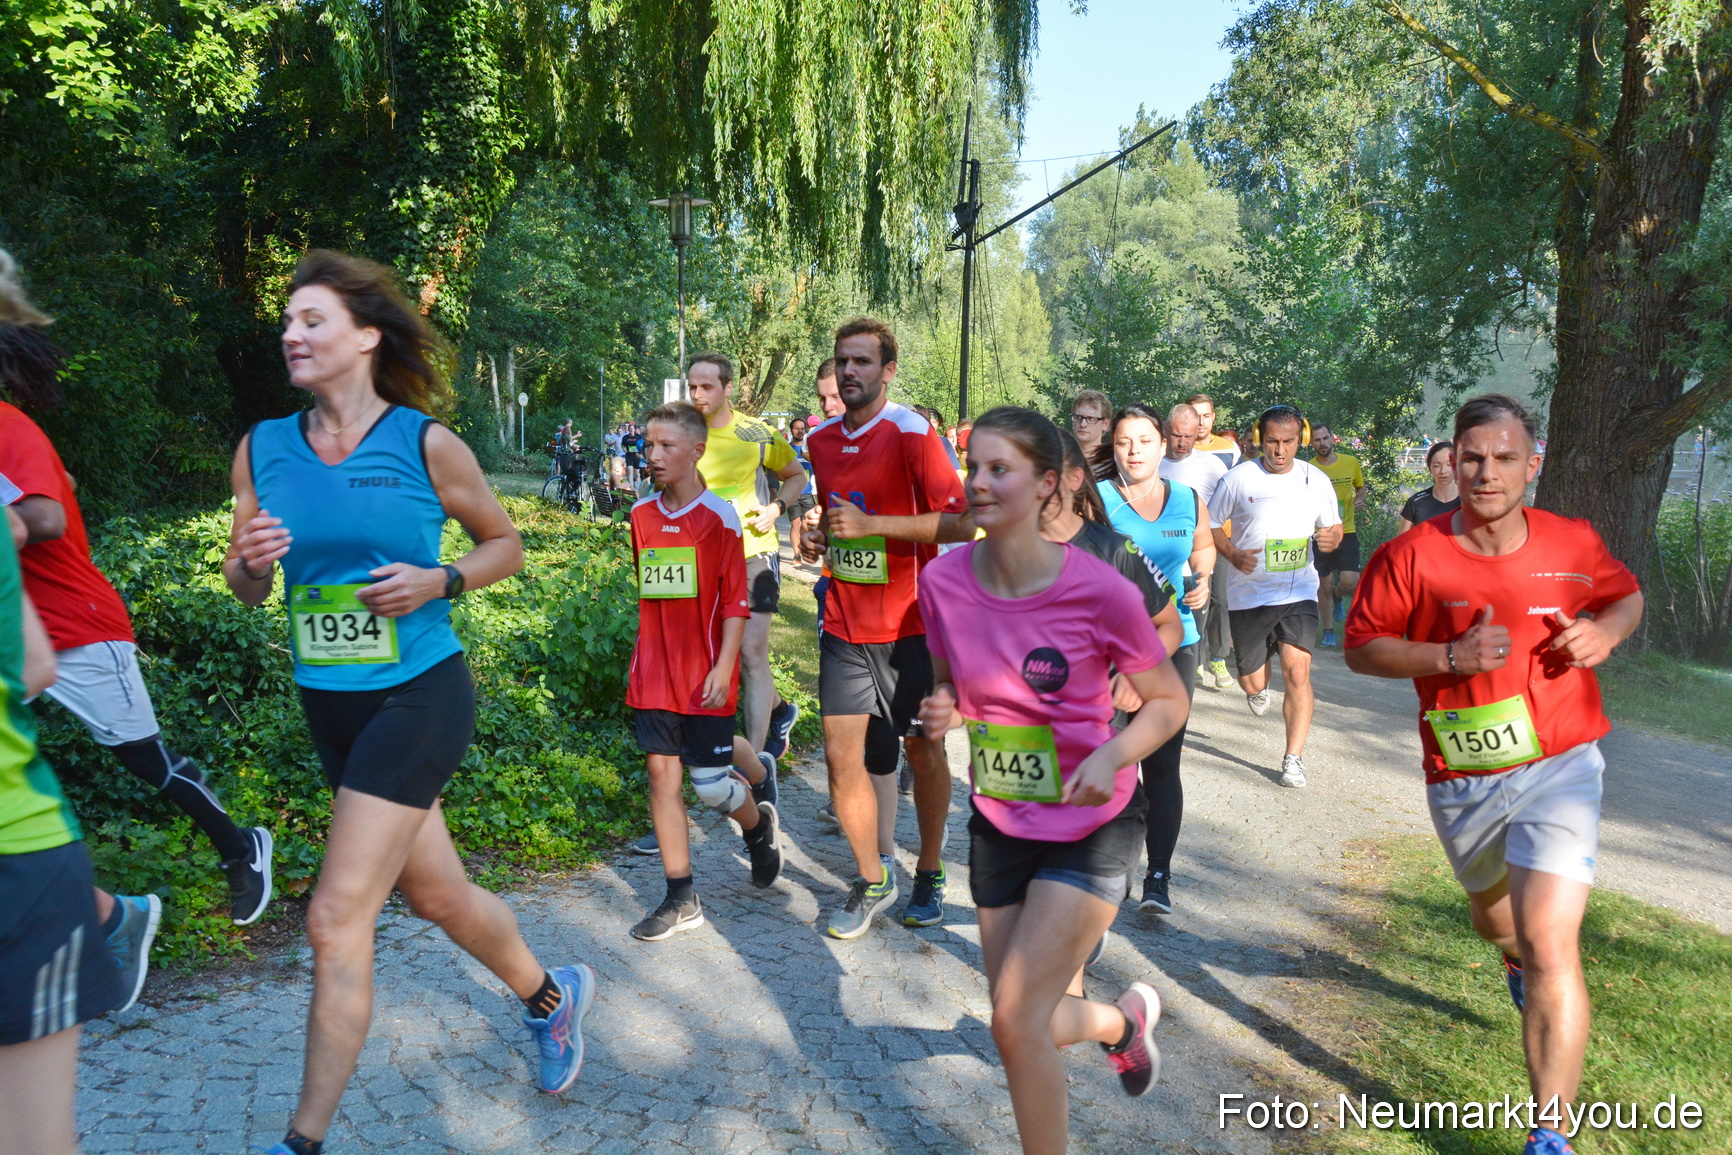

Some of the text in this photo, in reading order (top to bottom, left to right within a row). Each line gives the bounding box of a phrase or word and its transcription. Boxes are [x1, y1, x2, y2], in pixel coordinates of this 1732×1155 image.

[842, 446, 859, 454] JAKO
[348, 476, 401, 489] THULE
[661, 525, 680, 533] JAKO
[1161, 529, 1187, 538] THULE
[835, 547, 877, 569] 1482
[1273, 547, 1304, 562] 1787
[644, 565, 685, 584] 2141
[304, 613, 381, 642] 1934
[1448, 723, 1519, 753] 1501
[978, 748, 1045, 781] 1443
